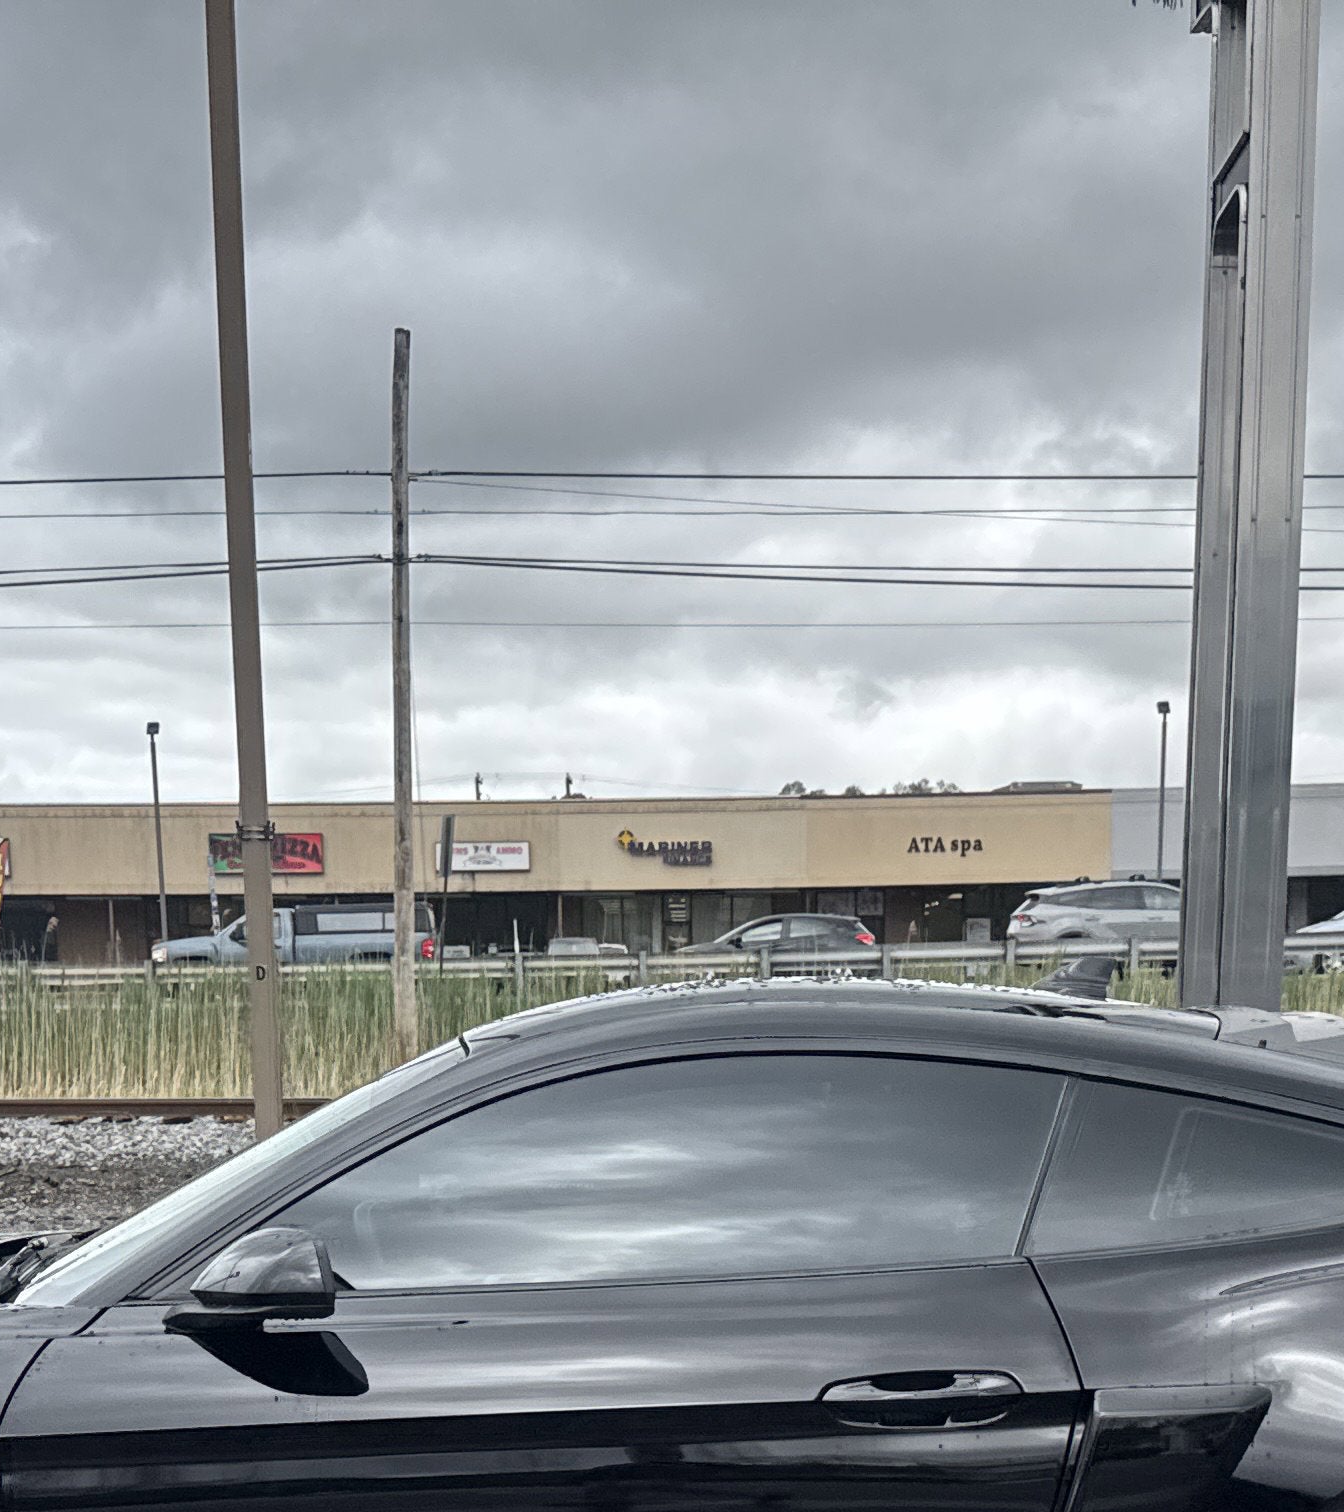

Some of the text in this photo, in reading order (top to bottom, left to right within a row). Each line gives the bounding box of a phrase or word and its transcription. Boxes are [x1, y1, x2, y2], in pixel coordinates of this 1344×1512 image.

[629, 841, 712, 856] MARINER
[907, 836, 983, 857] ATA spa
[256, 965, 266, 981] D
